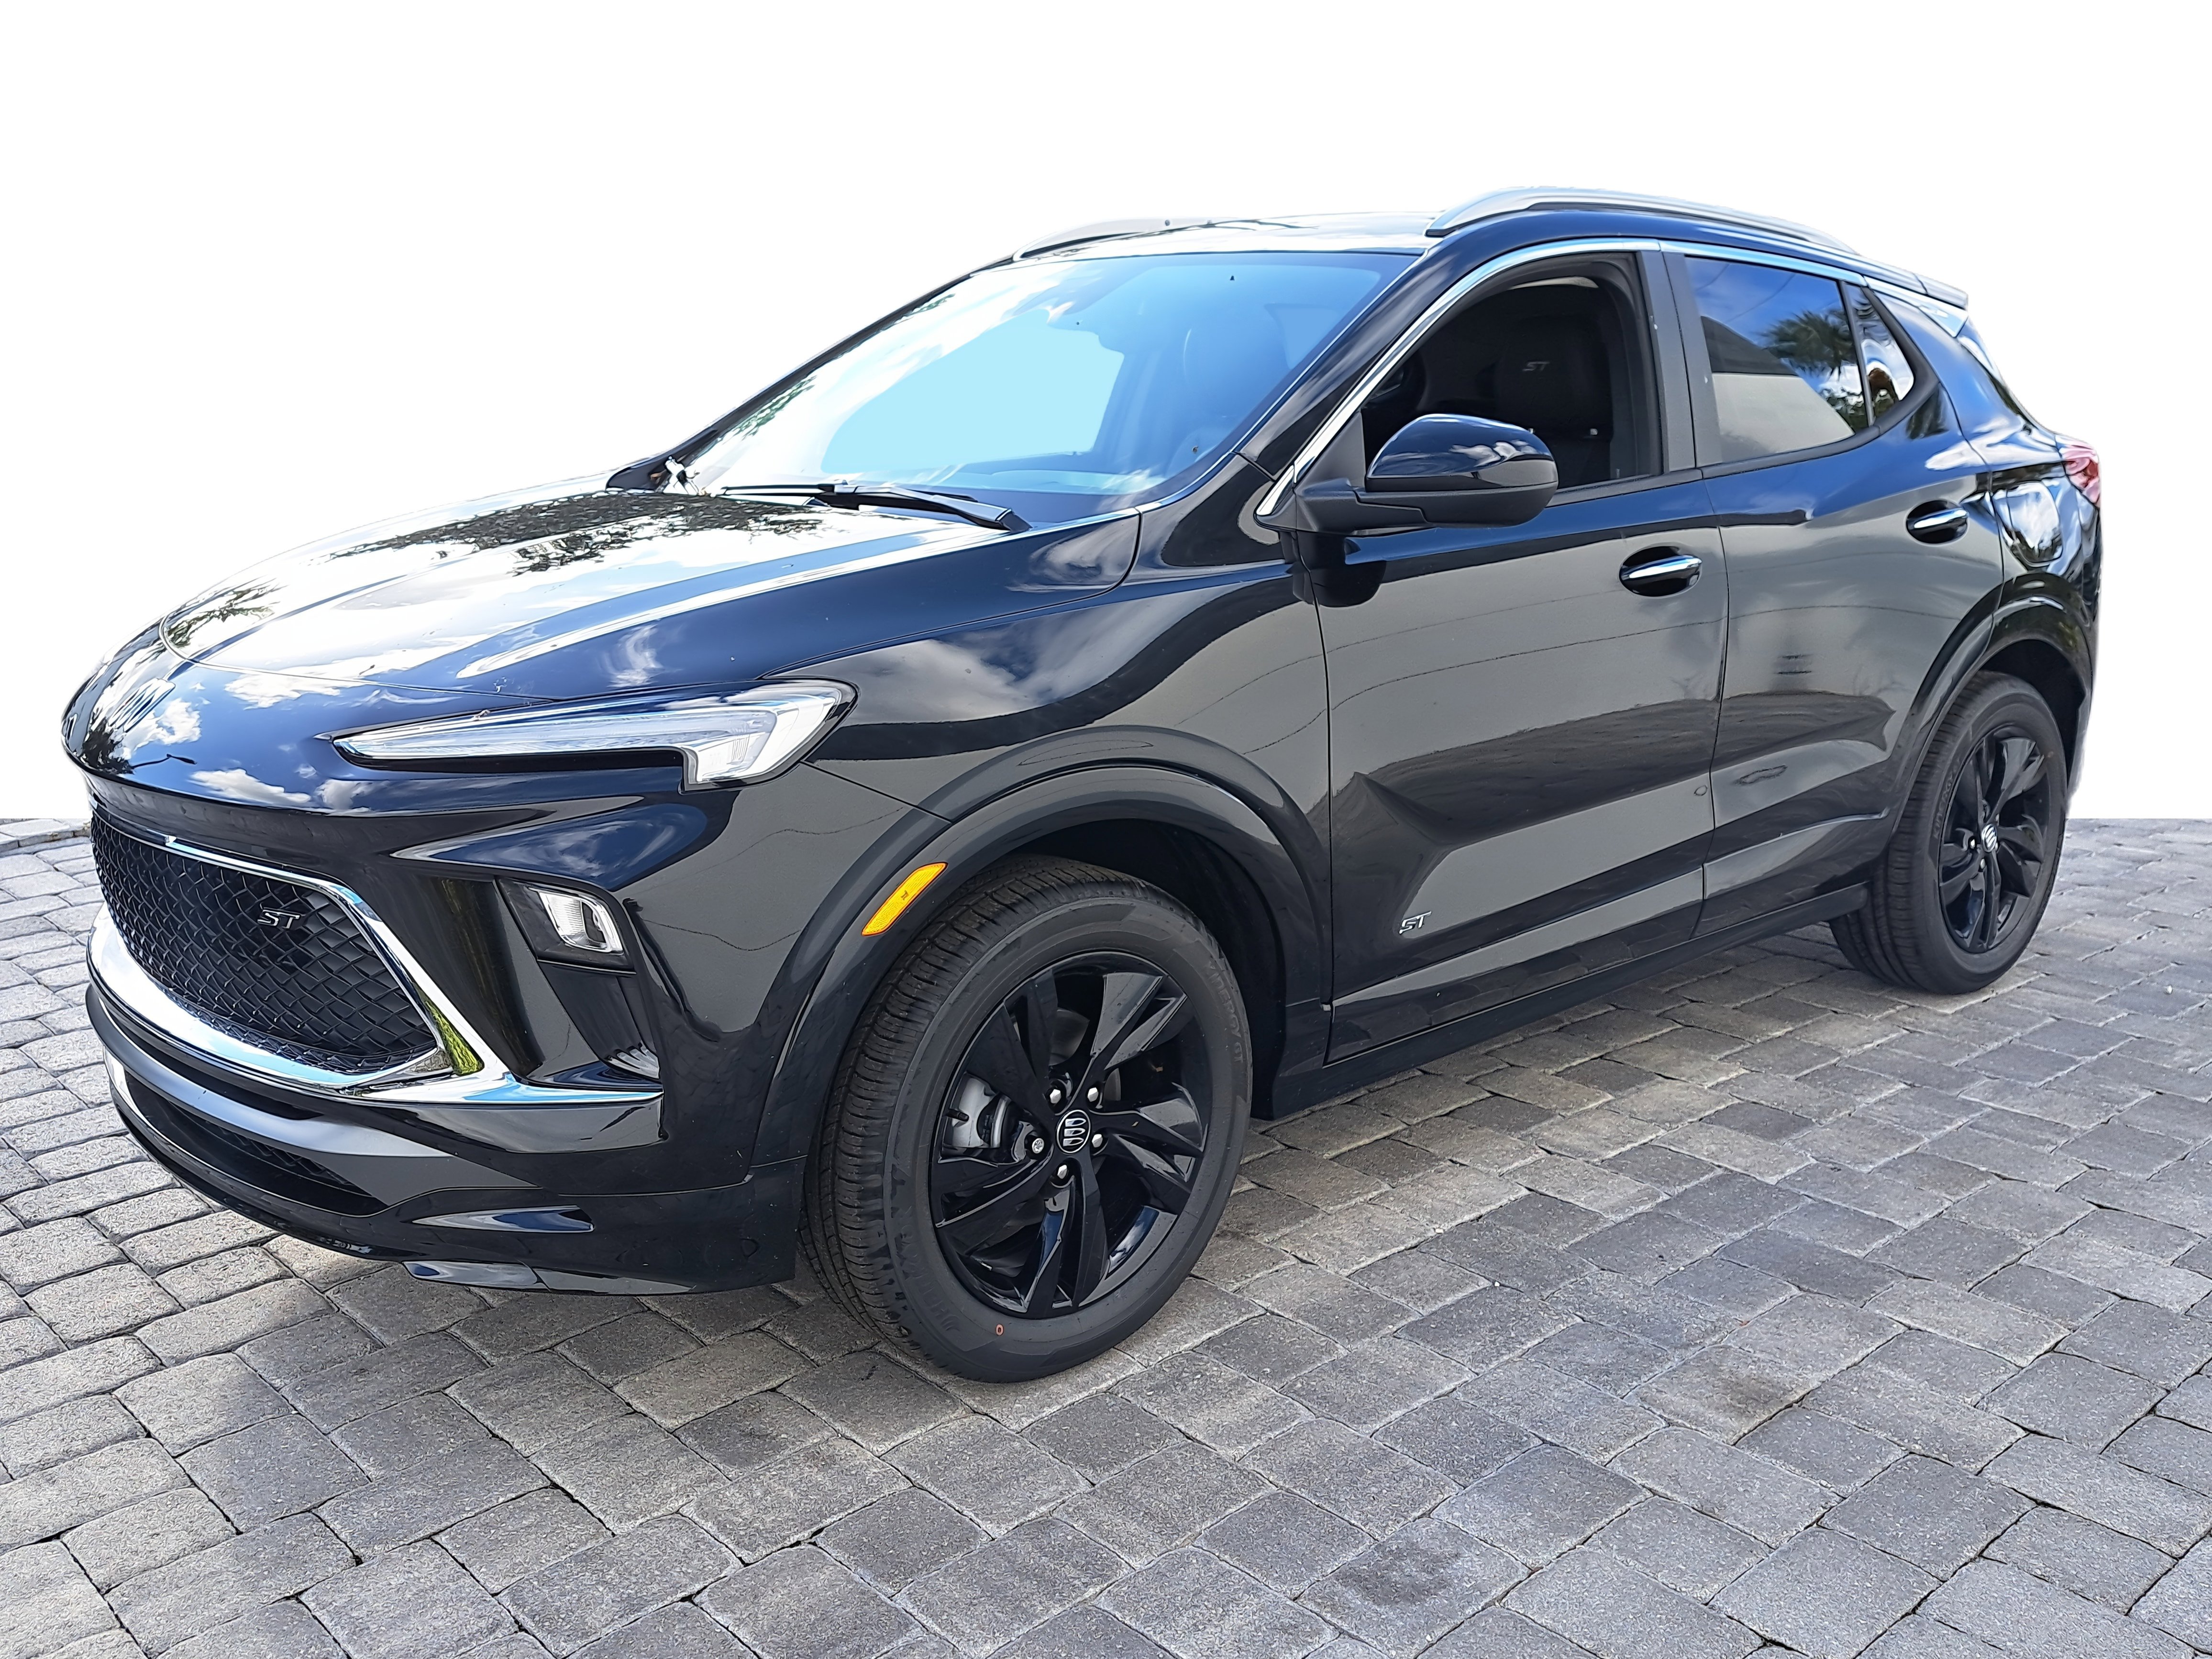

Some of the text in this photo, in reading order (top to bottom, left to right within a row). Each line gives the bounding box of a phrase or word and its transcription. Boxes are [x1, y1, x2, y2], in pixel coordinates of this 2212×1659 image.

[1522, 361, 1550, 371] ST
[257, 909, 300, 929] ST
[1399, 910, 1432, 934] ST
